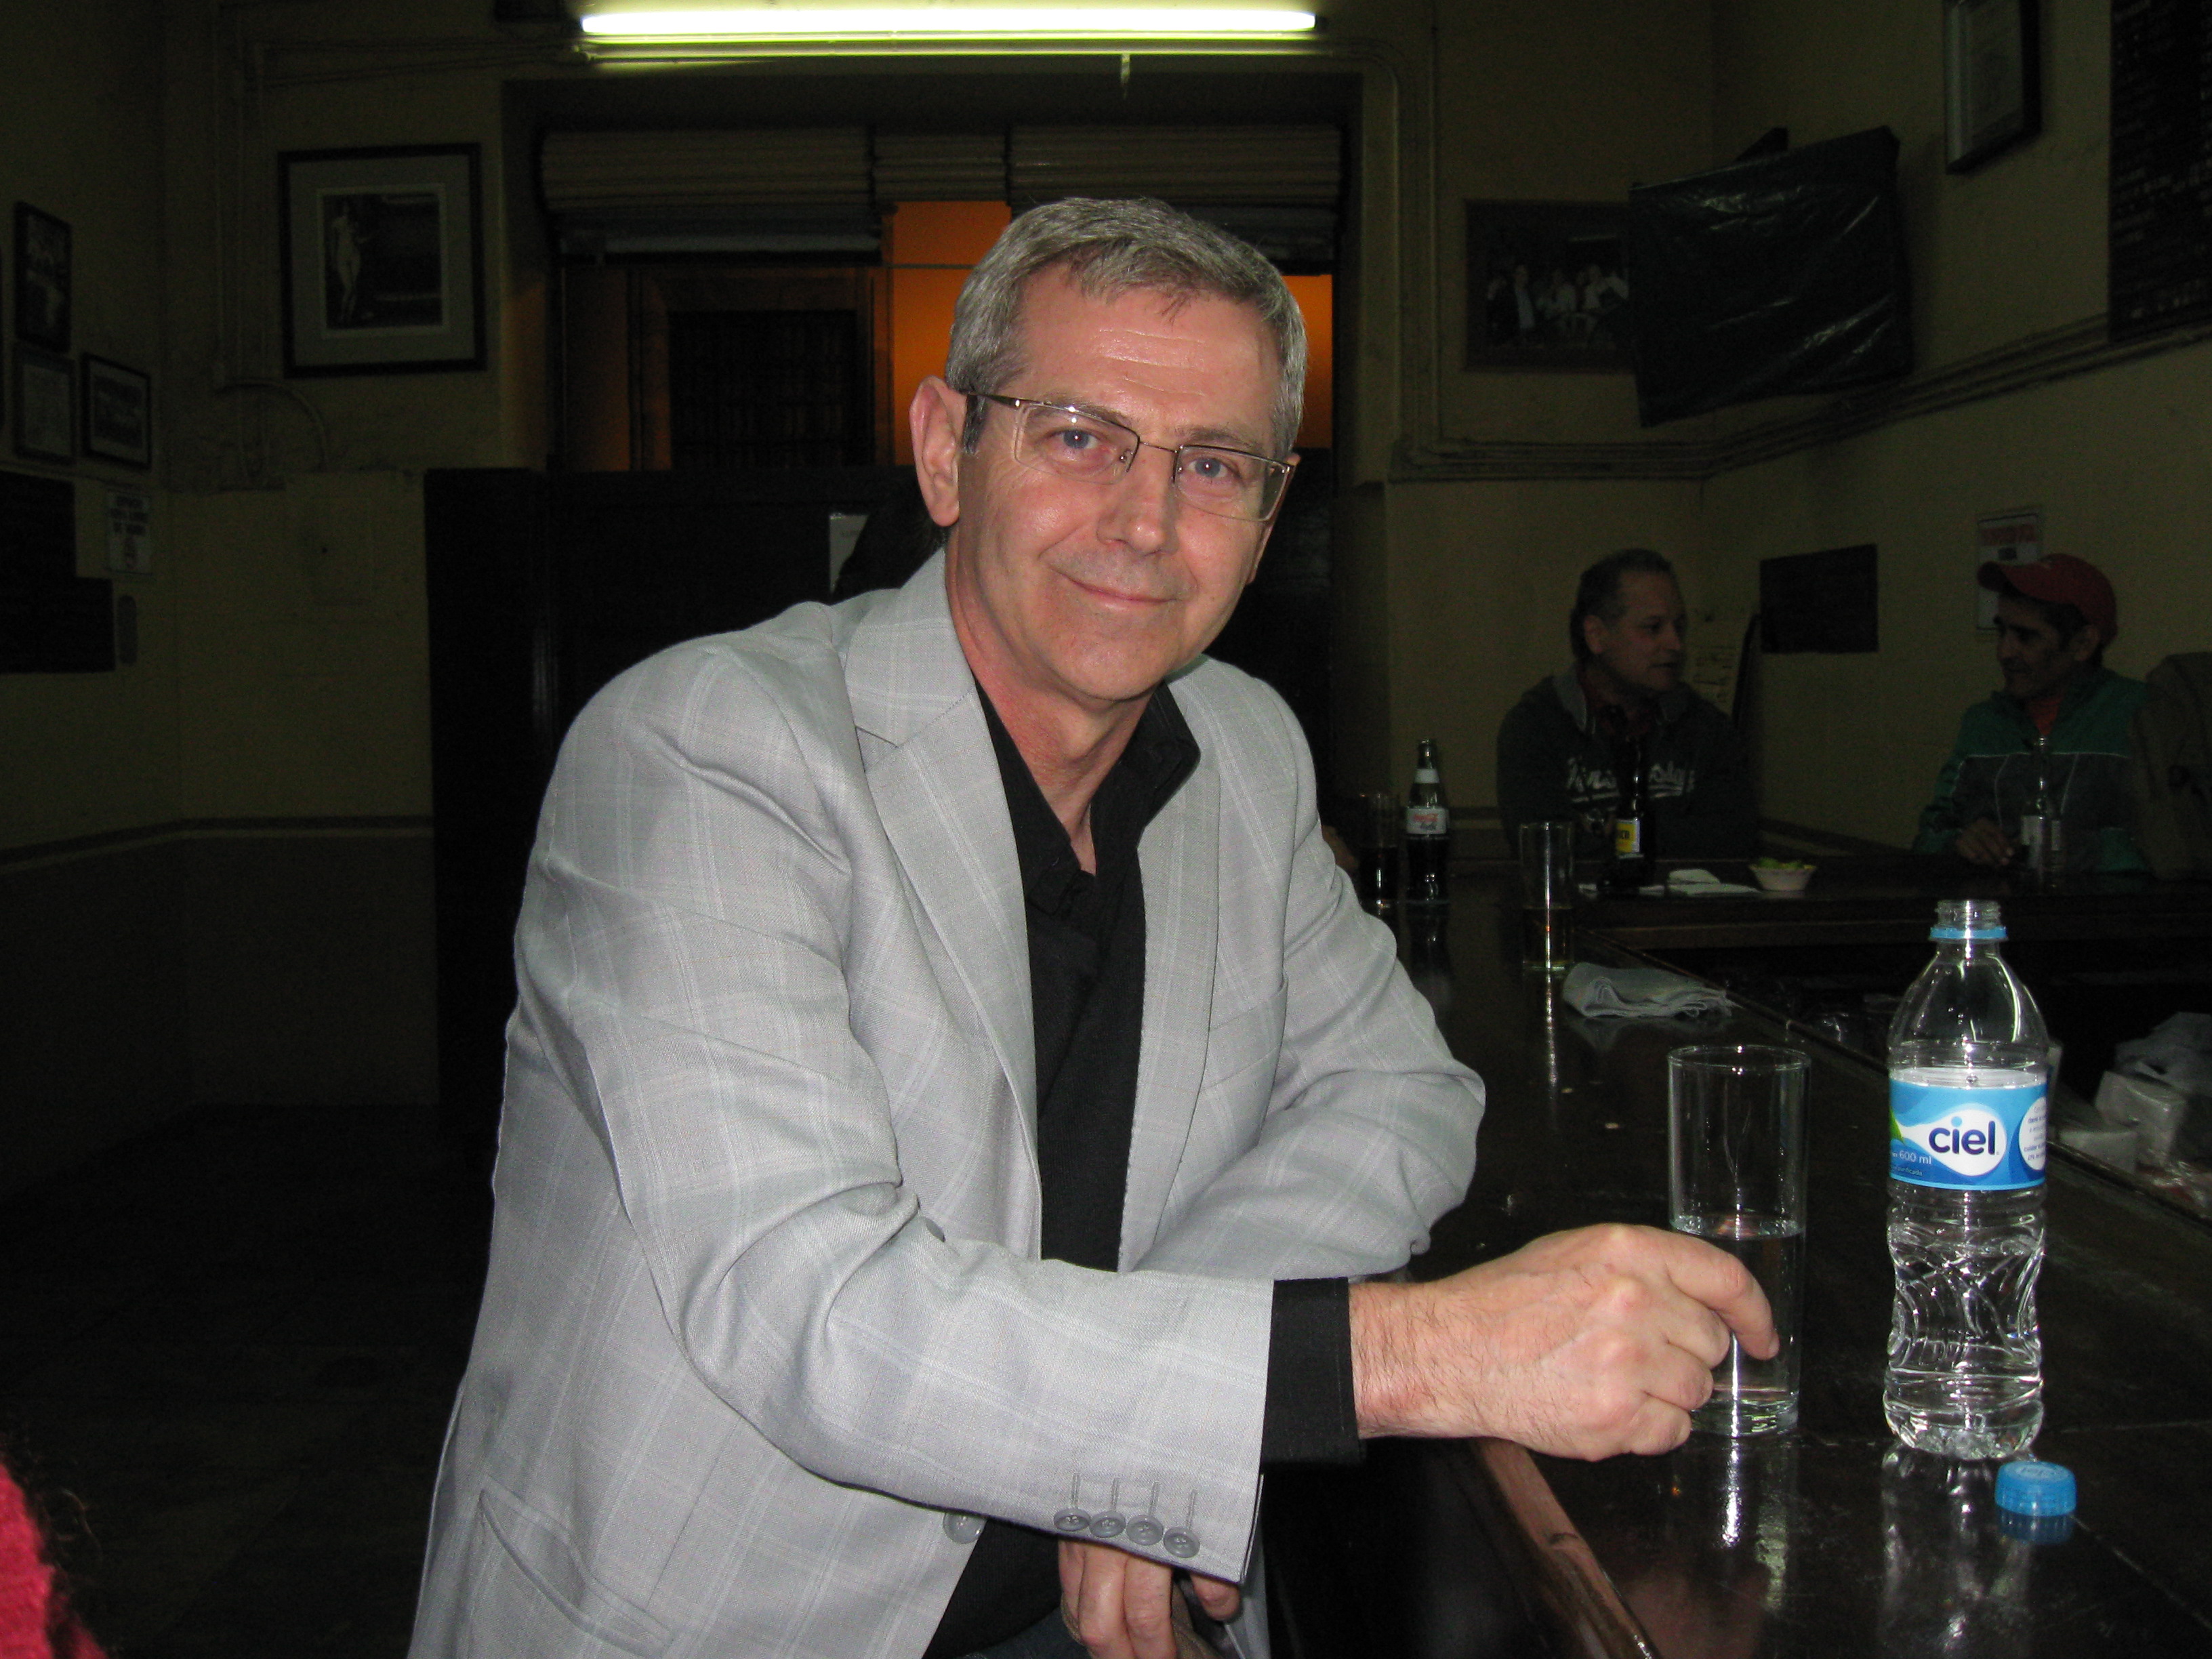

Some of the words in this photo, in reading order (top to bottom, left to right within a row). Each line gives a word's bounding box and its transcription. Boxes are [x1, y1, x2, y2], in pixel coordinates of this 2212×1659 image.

[1928, 1116, 1996, 1155] ciel
[1899, 1150, 1917, 1162] 600
[1919, 1155, 1931, 1164] ml
